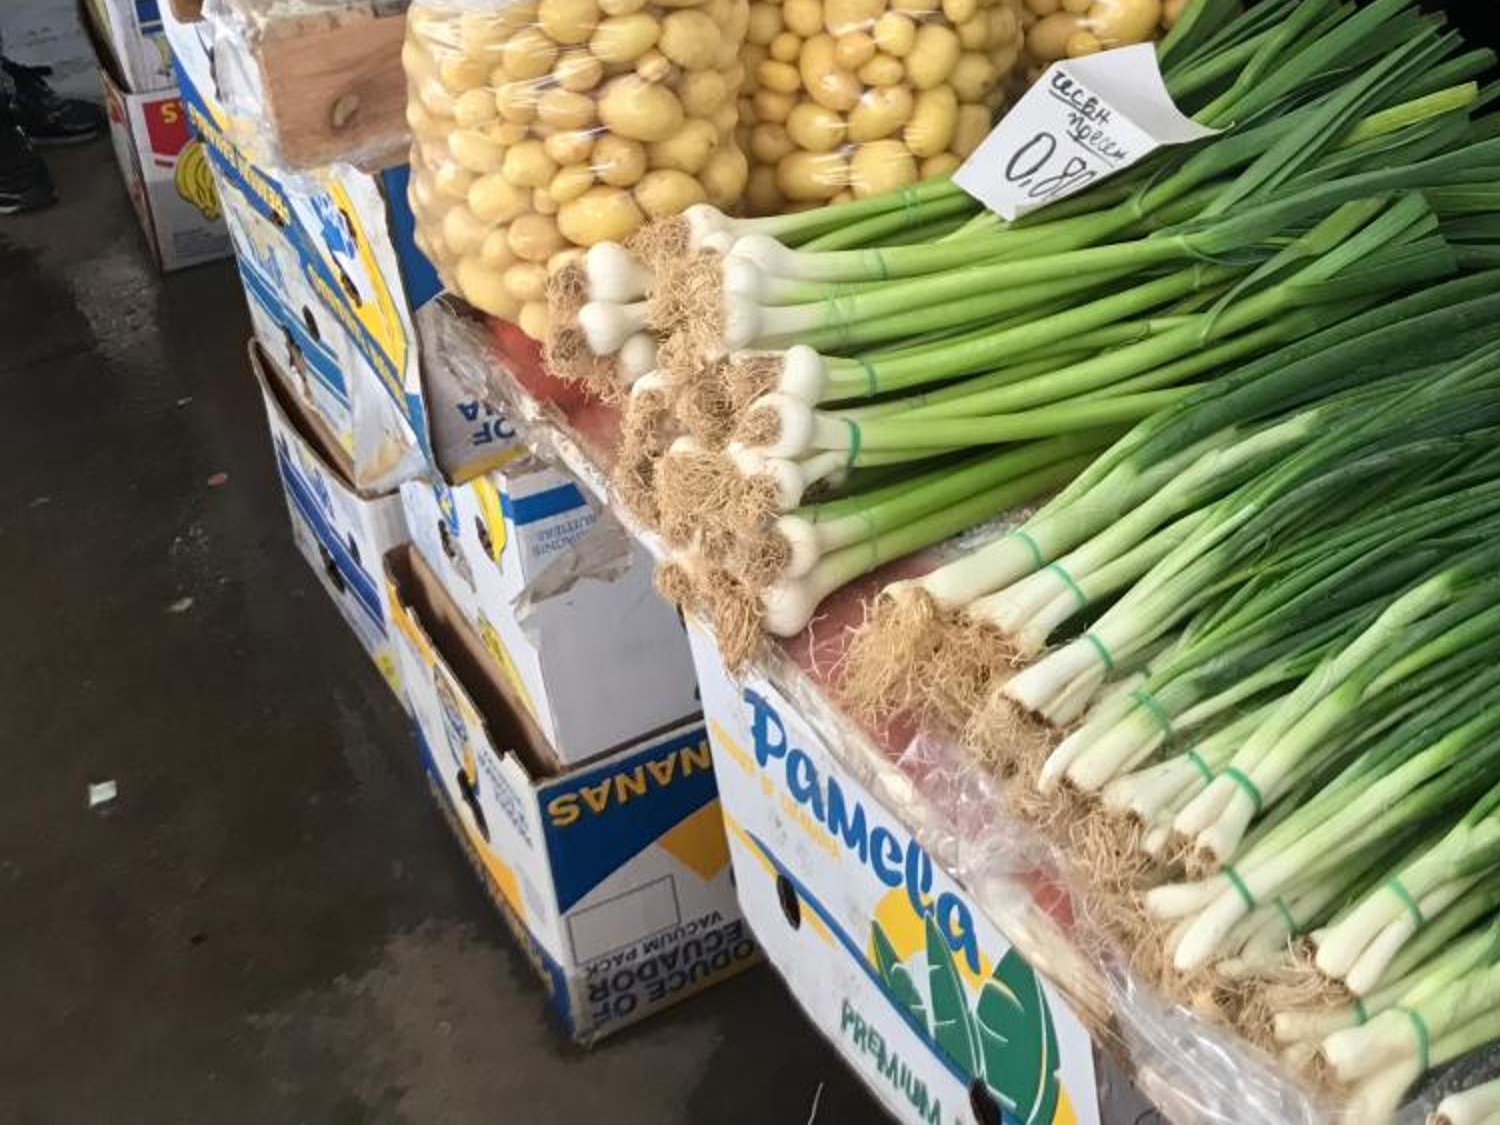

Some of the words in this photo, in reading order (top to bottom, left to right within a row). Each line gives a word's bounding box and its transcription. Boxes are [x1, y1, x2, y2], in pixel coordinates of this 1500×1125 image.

[642, 910, 724, 955] VACUUM
[585, 942, 638, 977] PACK
[587, 918, 743, 1002] ECUADOR
